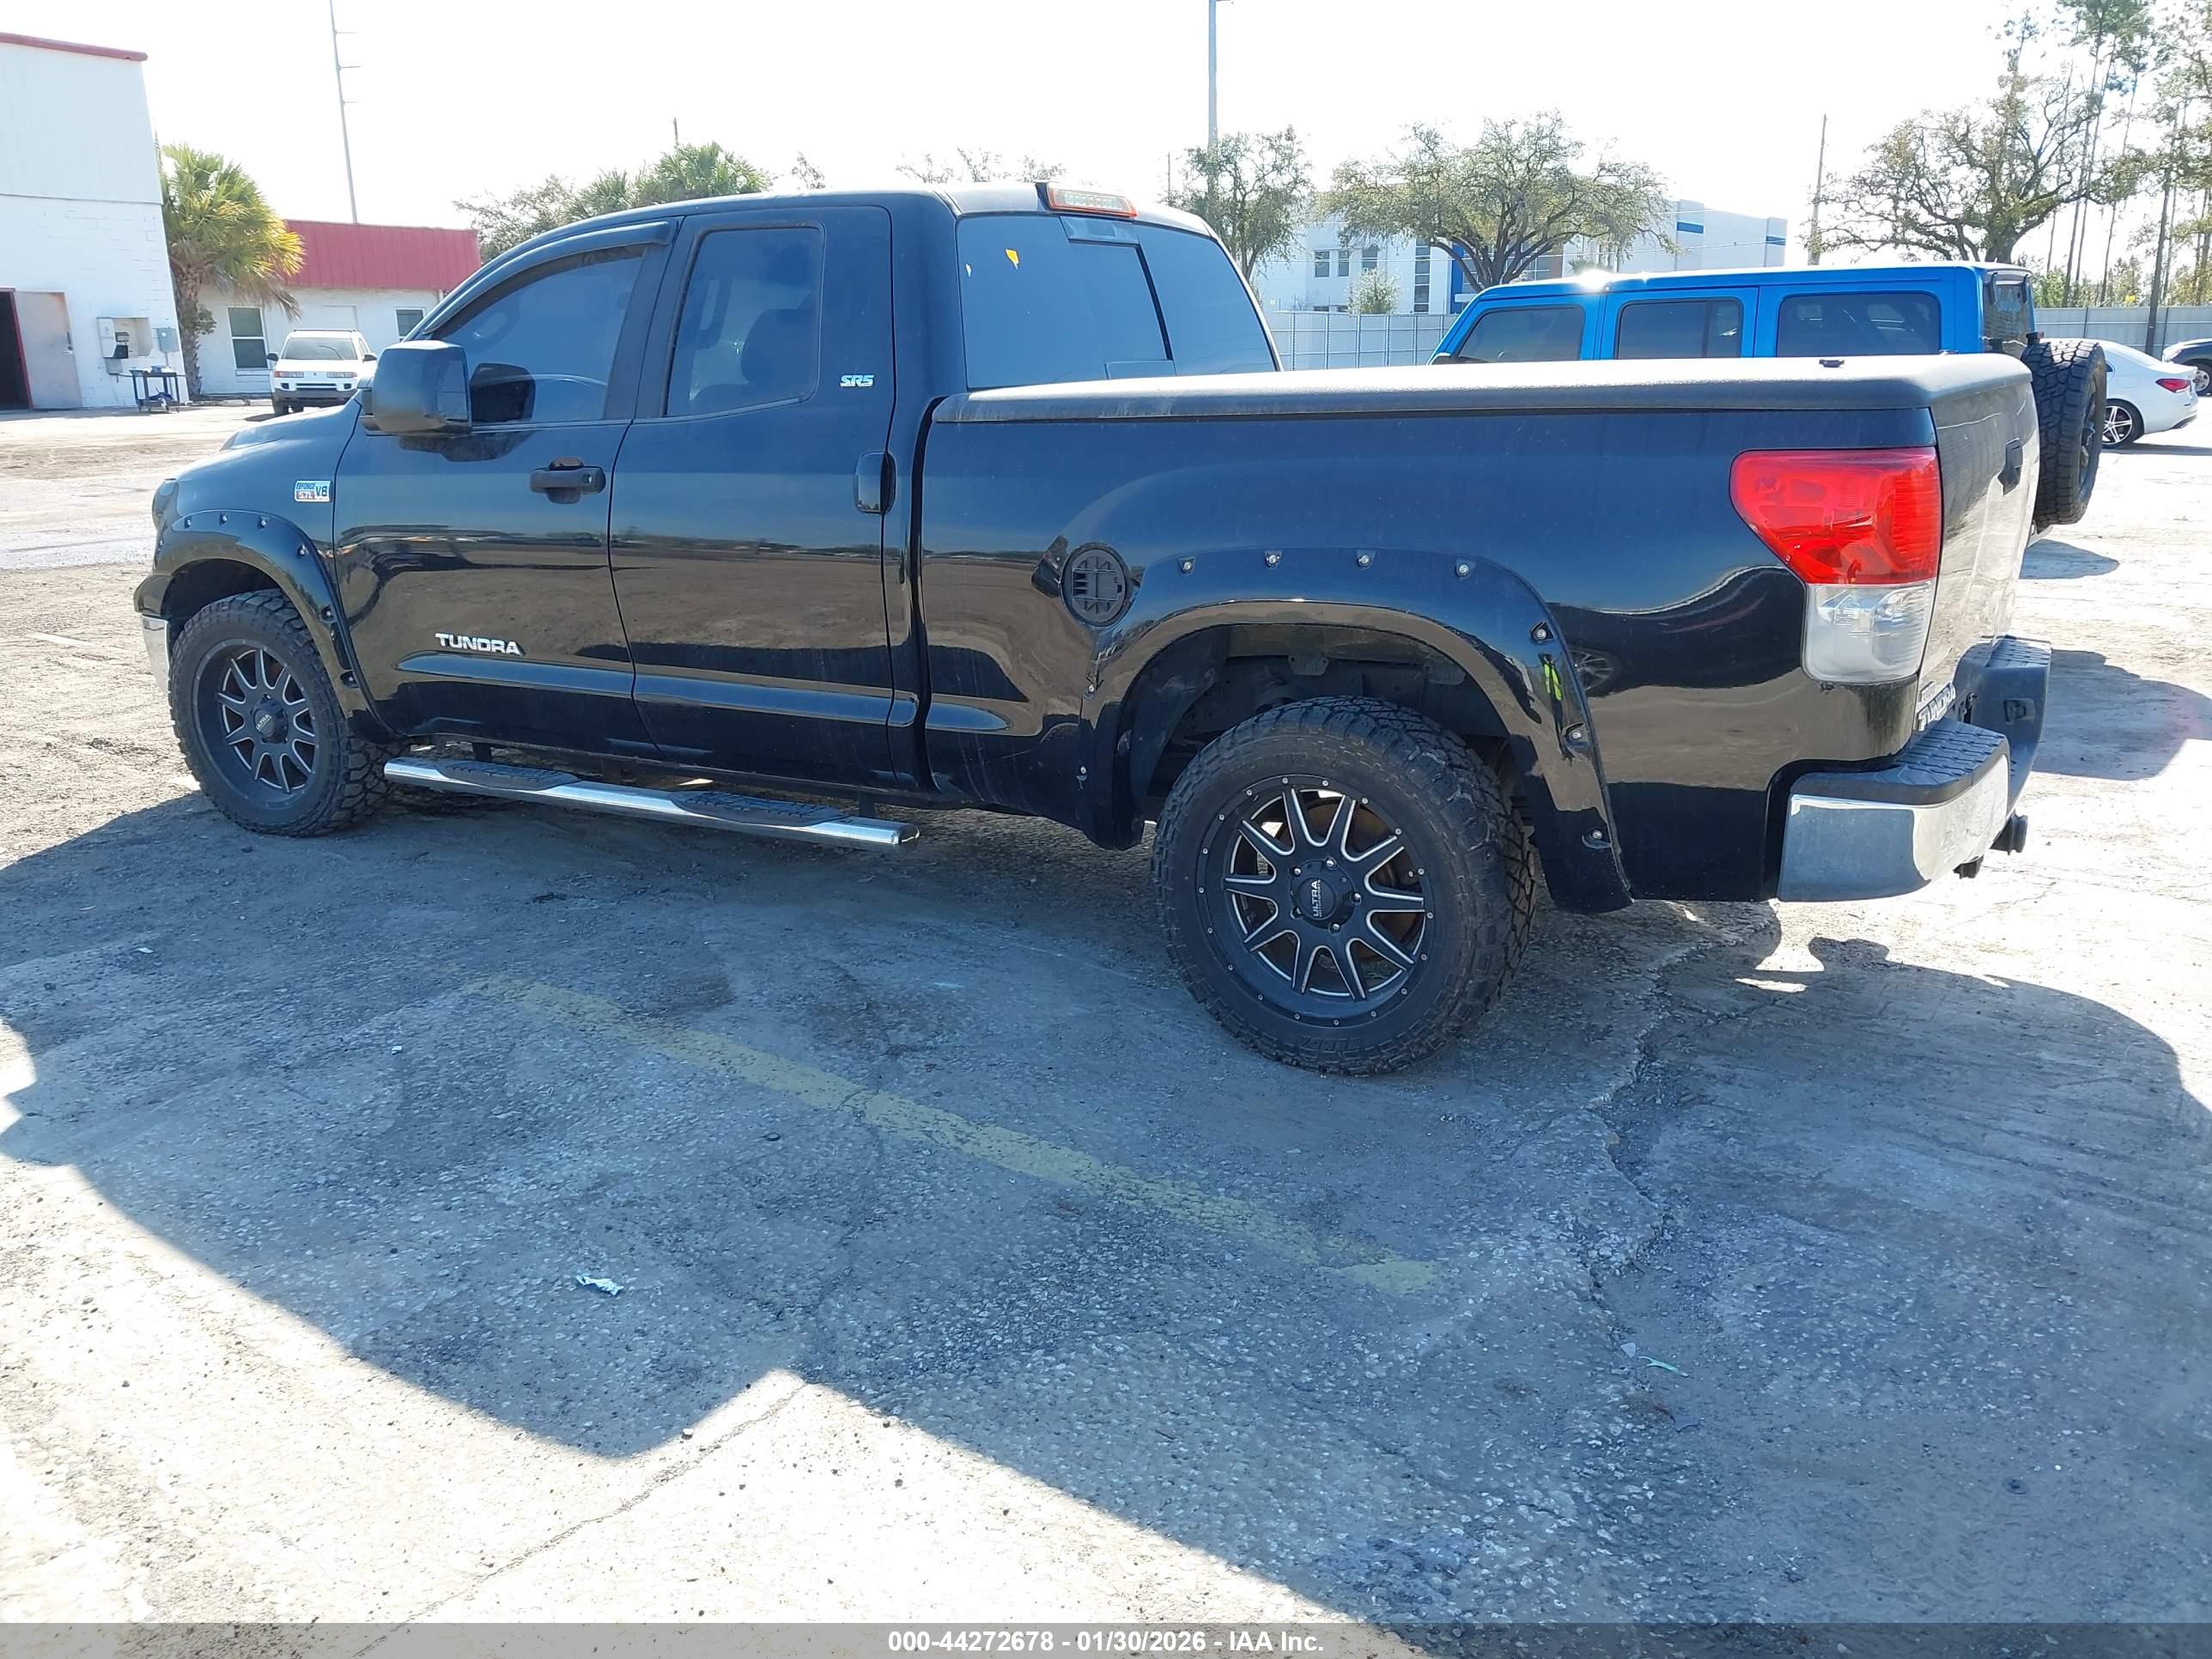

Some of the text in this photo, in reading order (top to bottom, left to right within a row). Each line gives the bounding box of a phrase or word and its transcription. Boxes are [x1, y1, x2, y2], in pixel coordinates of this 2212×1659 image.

[841, 374, 874, 387] SR5
[316, 485, 328, 497] V8
[434, 633, 522, 656] TUNDRA
[1917, 683, 1956, 732] TUNDRA
